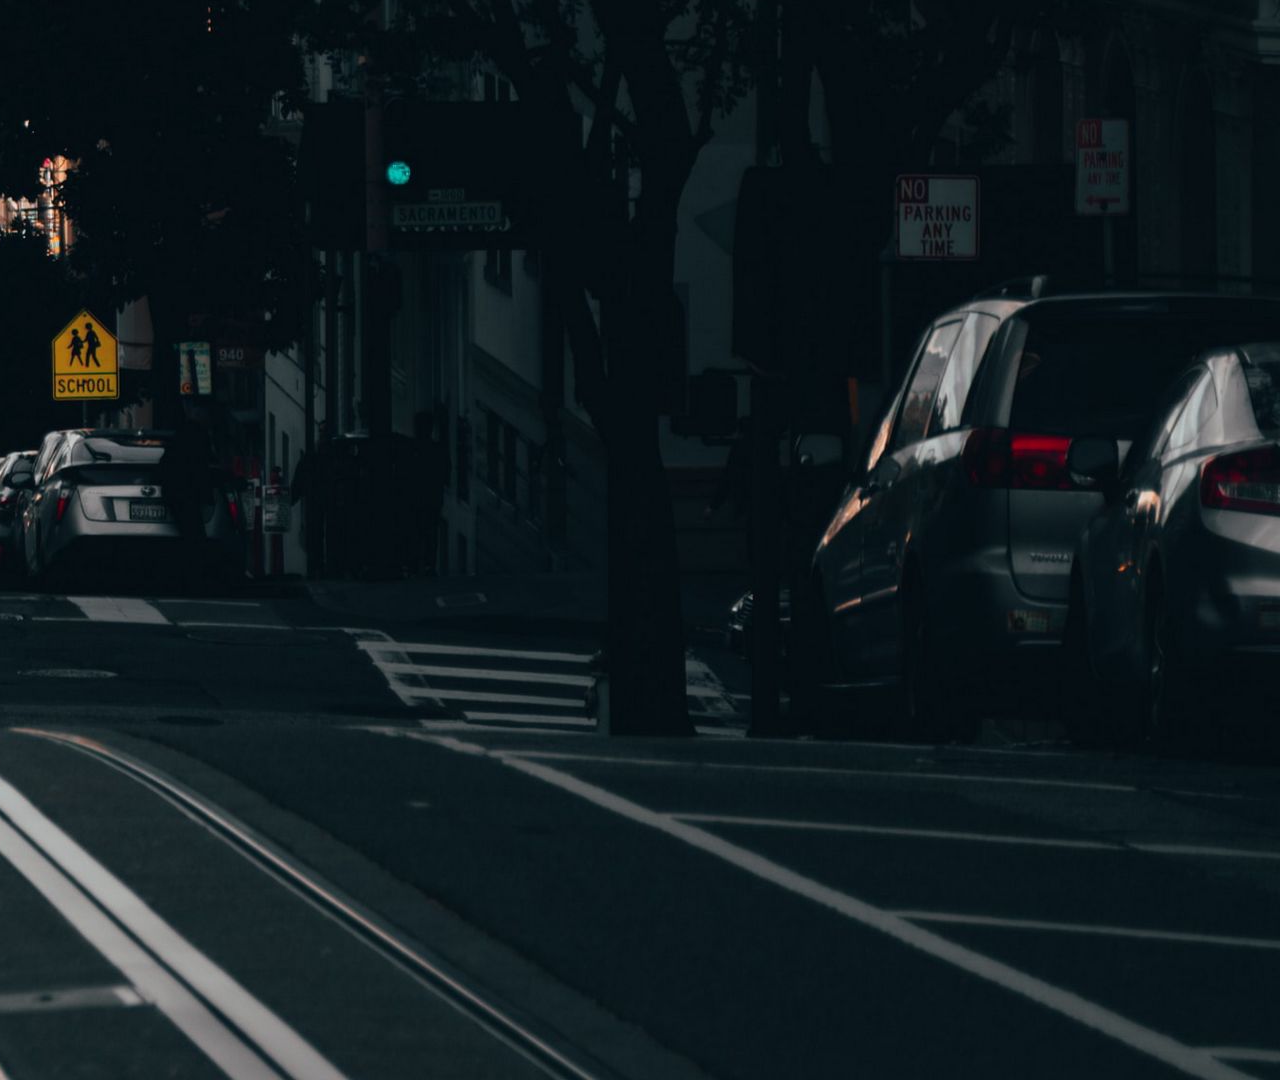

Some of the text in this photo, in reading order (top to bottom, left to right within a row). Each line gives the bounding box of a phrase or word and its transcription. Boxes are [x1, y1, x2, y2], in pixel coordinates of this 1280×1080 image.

[1082, 122, 1098, 145] NO
[900, 178, 927, 201] NO
[398, 206, 496, 223] SACRAMENTO
[903, 205, 972, 222] PARKING
[921, 222, 954, 239] ANY
[920, 239, 956, 257] TIME
[219, 348, 244, 361] 940
[57, 377, 115, 394] SCHOOL
[1029, 551, 1072, 563] TOYOTA
